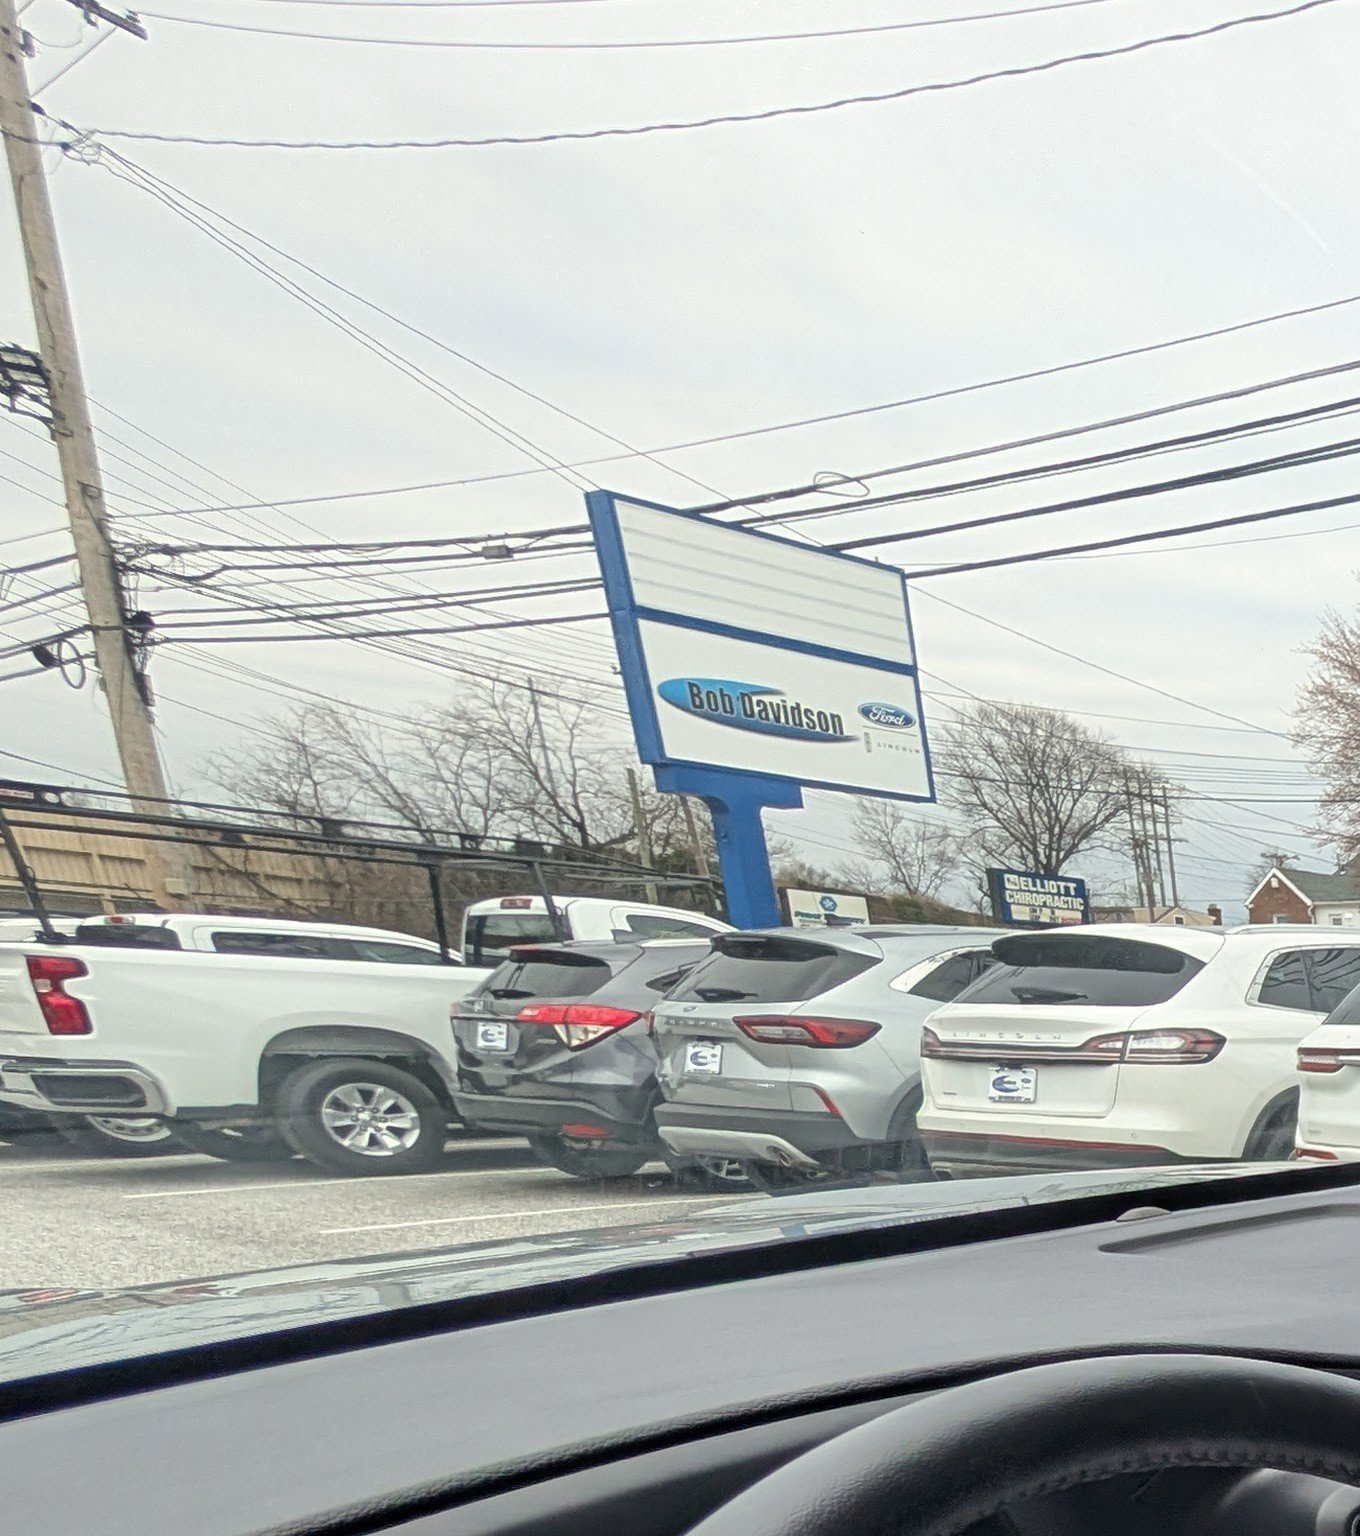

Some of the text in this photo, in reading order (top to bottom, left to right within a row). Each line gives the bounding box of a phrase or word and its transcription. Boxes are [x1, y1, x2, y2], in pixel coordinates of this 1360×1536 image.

[687, 681, 845, 736] Bob Davidson
[867, 705, 907, 727] Ford
[1019, 876, 1077, 896] ELLIOTT
[1004, 890, 1085, 911] CHIROPRACTIC
